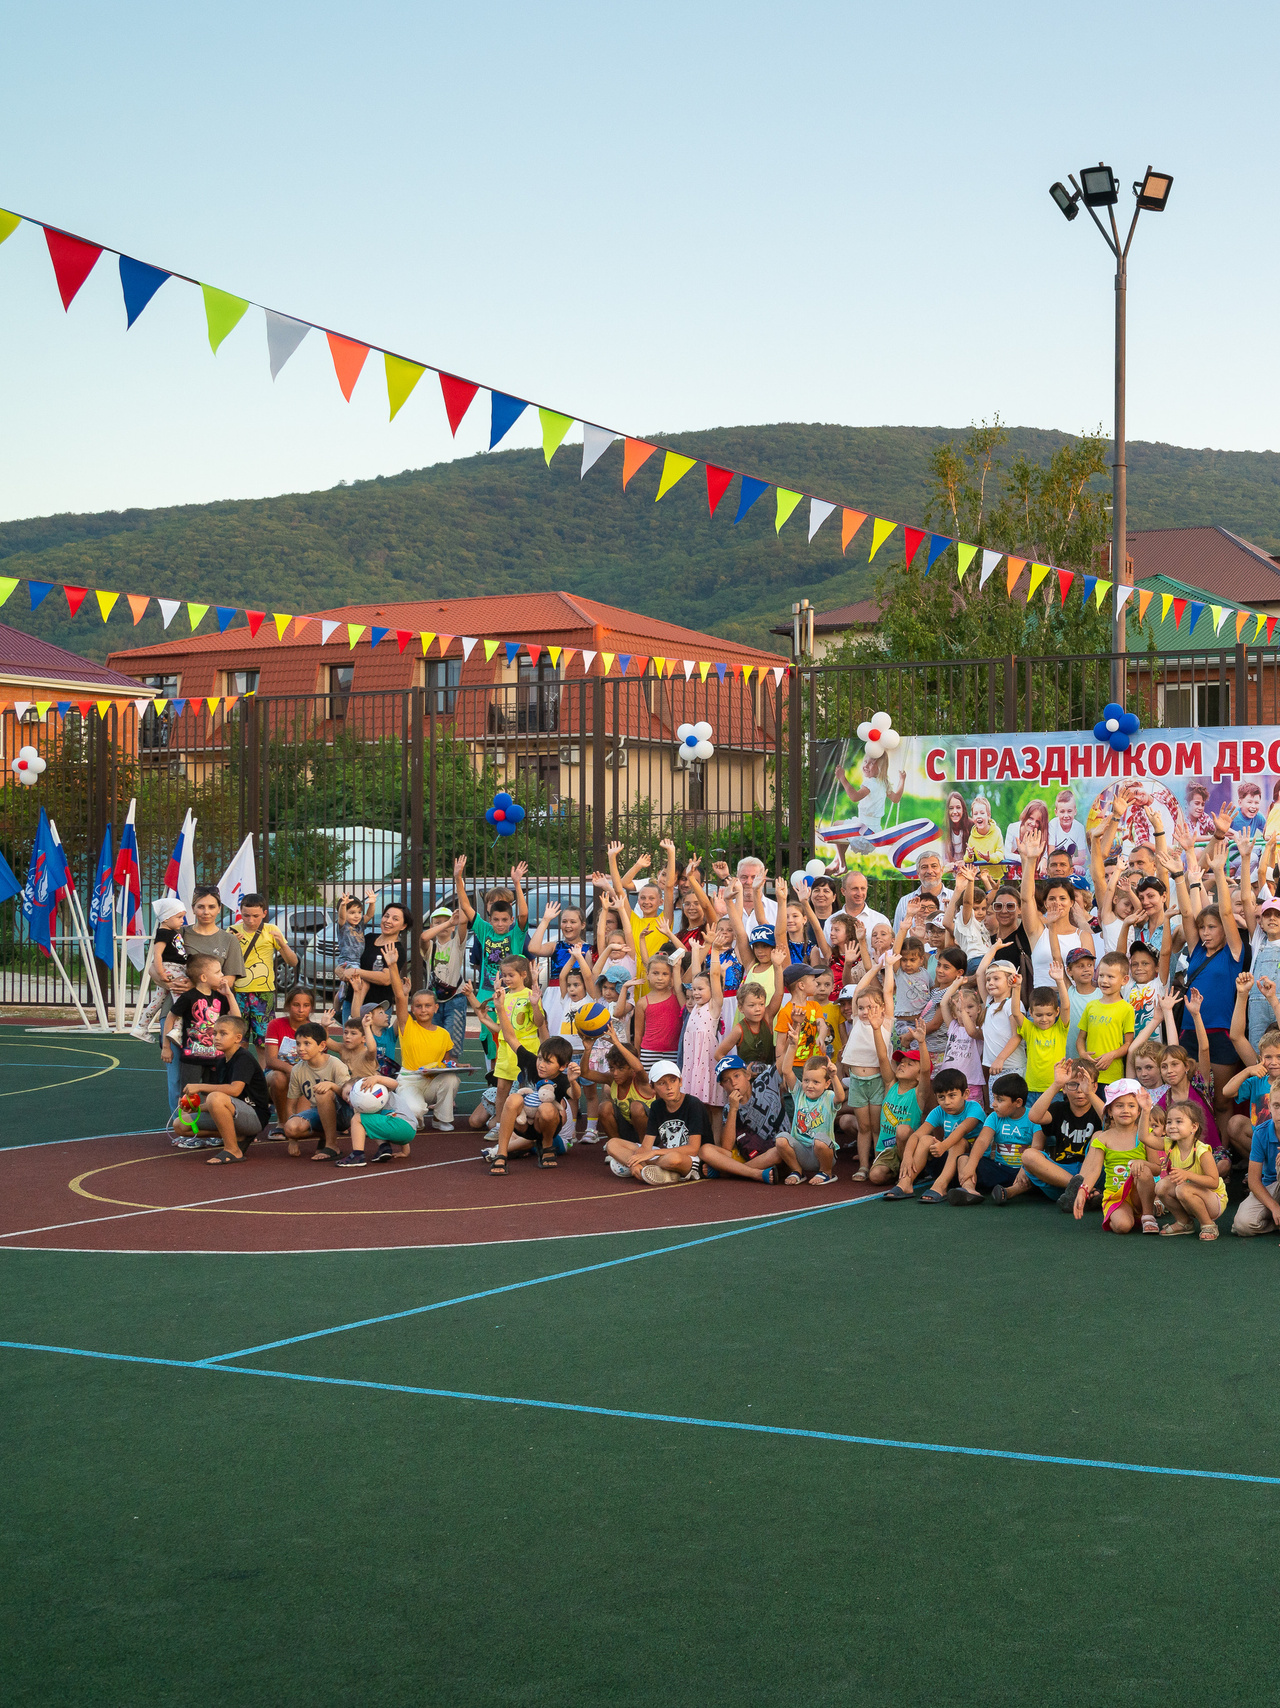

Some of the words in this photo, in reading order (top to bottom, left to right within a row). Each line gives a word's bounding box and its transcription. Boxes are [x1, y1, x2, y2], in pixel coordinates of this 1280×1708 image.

[926, 749, 946, 781] С
[956, 742, 1203, 786] ПРАЗДНИКОМ
[1002, 1124, 1021, 1136] EA
